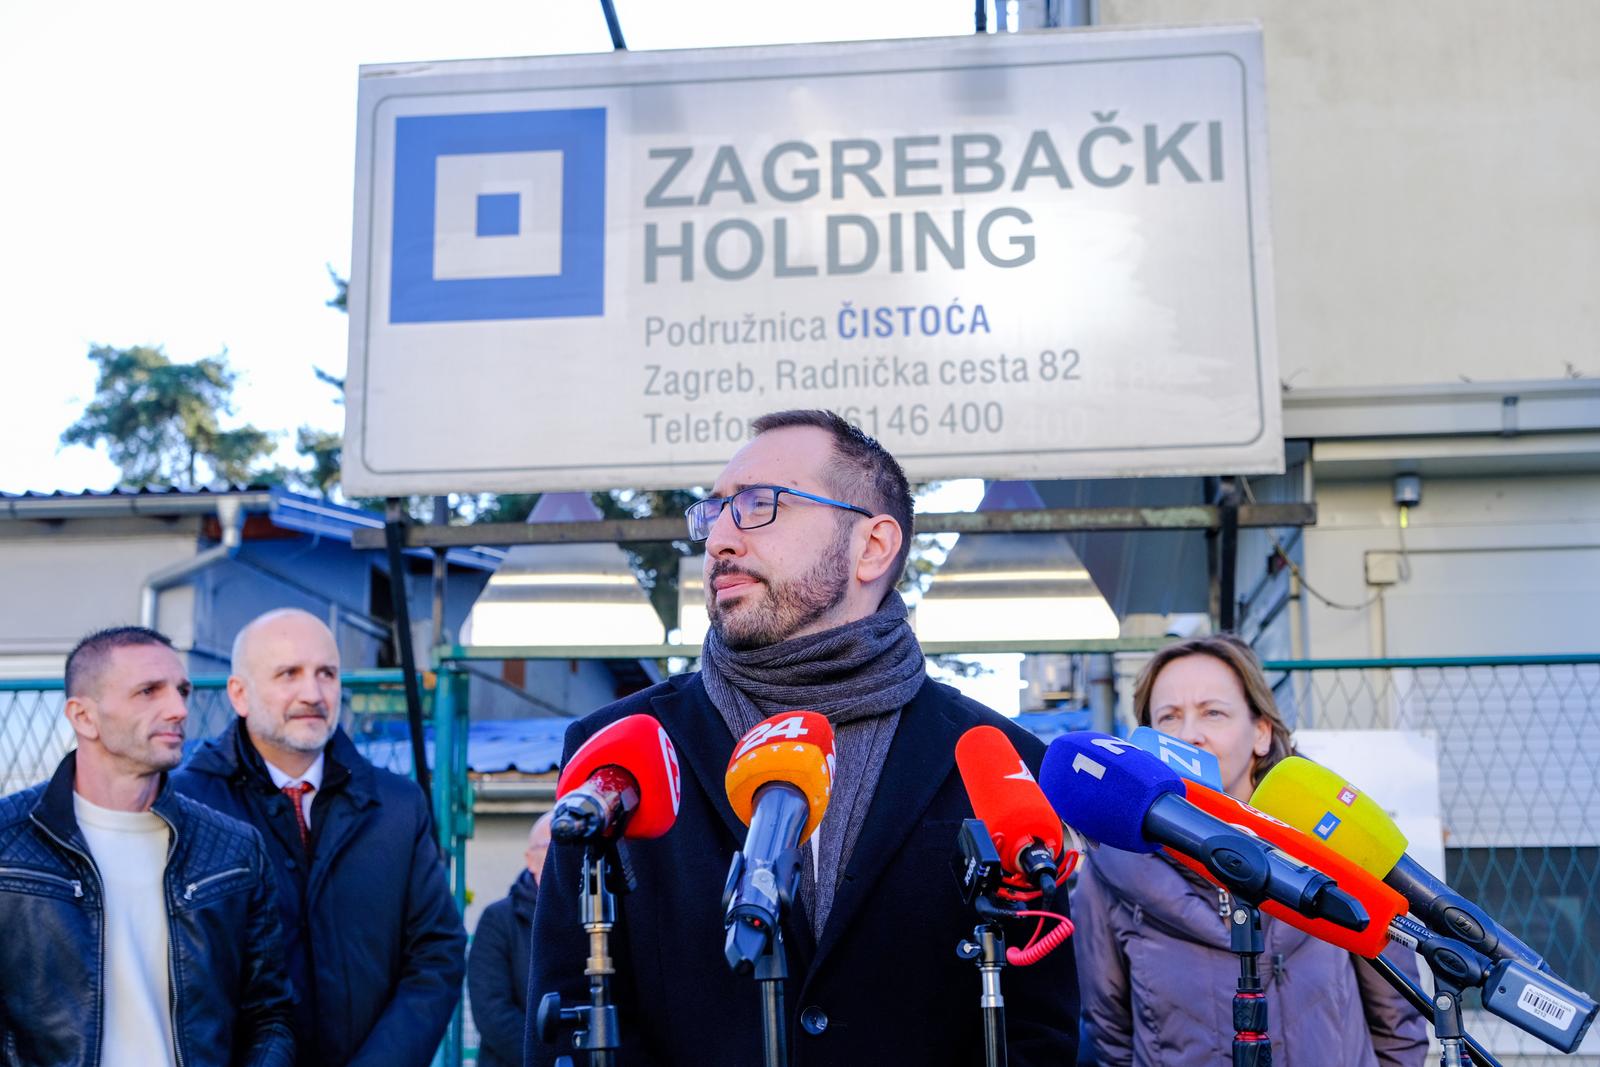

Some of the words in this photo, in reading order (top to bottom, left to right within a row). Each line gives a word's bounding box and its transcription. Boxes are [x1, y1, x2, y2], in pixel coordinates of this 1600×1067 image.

[644, 110, 1225, 208] ZAGREBAČKI
[644, 207, 1036, 283] HOLDING
[645, 312, 827, 348] Podružnica
[837, 298, 991, 339] ČISTOĆA
[643, 361, 765, 401] Zagreb,
[776, 356, 930, 391] Radnička
[939, 353, 1029, 385] cesta
[1040, 349, 1081, 381] 82
[938, 401, 1003, 435] 400
[735, 716, 809, 760] 24
[1071, 751, 1107, 781] 1
